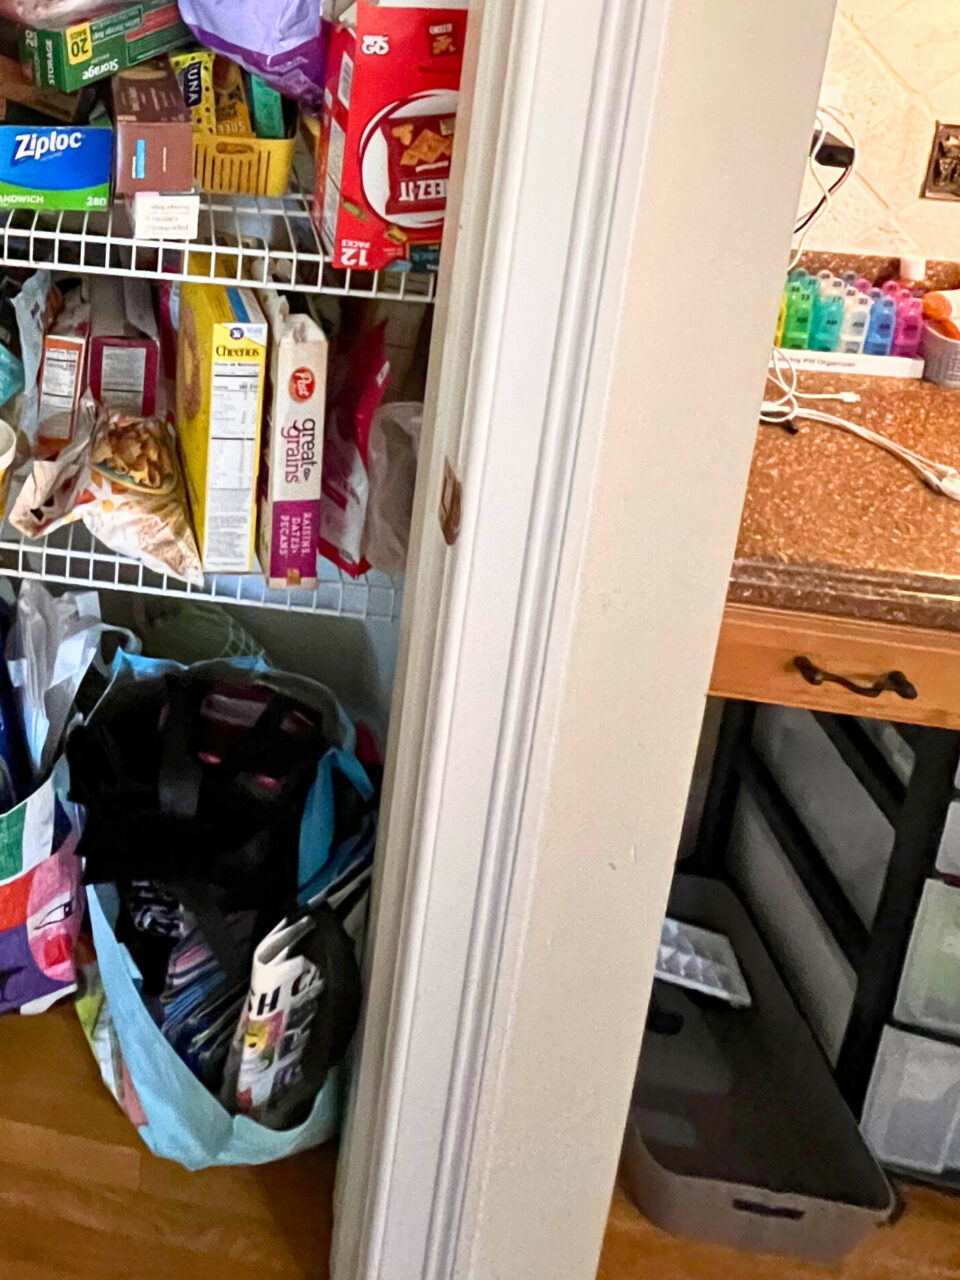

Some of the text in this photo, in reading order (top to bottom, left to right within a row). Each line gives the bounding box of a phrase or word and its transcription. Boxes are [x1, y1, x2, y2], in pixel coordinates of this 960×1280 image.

[70, 37, 89, 58] 20
[44, 39, 56, 86] STORAGE
[82, 58, 119, 81] Storage
[14, 130, 83, 161] Ziploc
[86, 196, 107, 207] 280
[341, 239, 371, 249] PACKS
[340, 248, 369, 267] 12
[215, 344, 260, 357] Cheerios
[294, 371, 313, 397] Post
[280, 422, 301, 484] grains
[300, 418, 316, 464] great
[279, 514, 290, 556] PECANS
